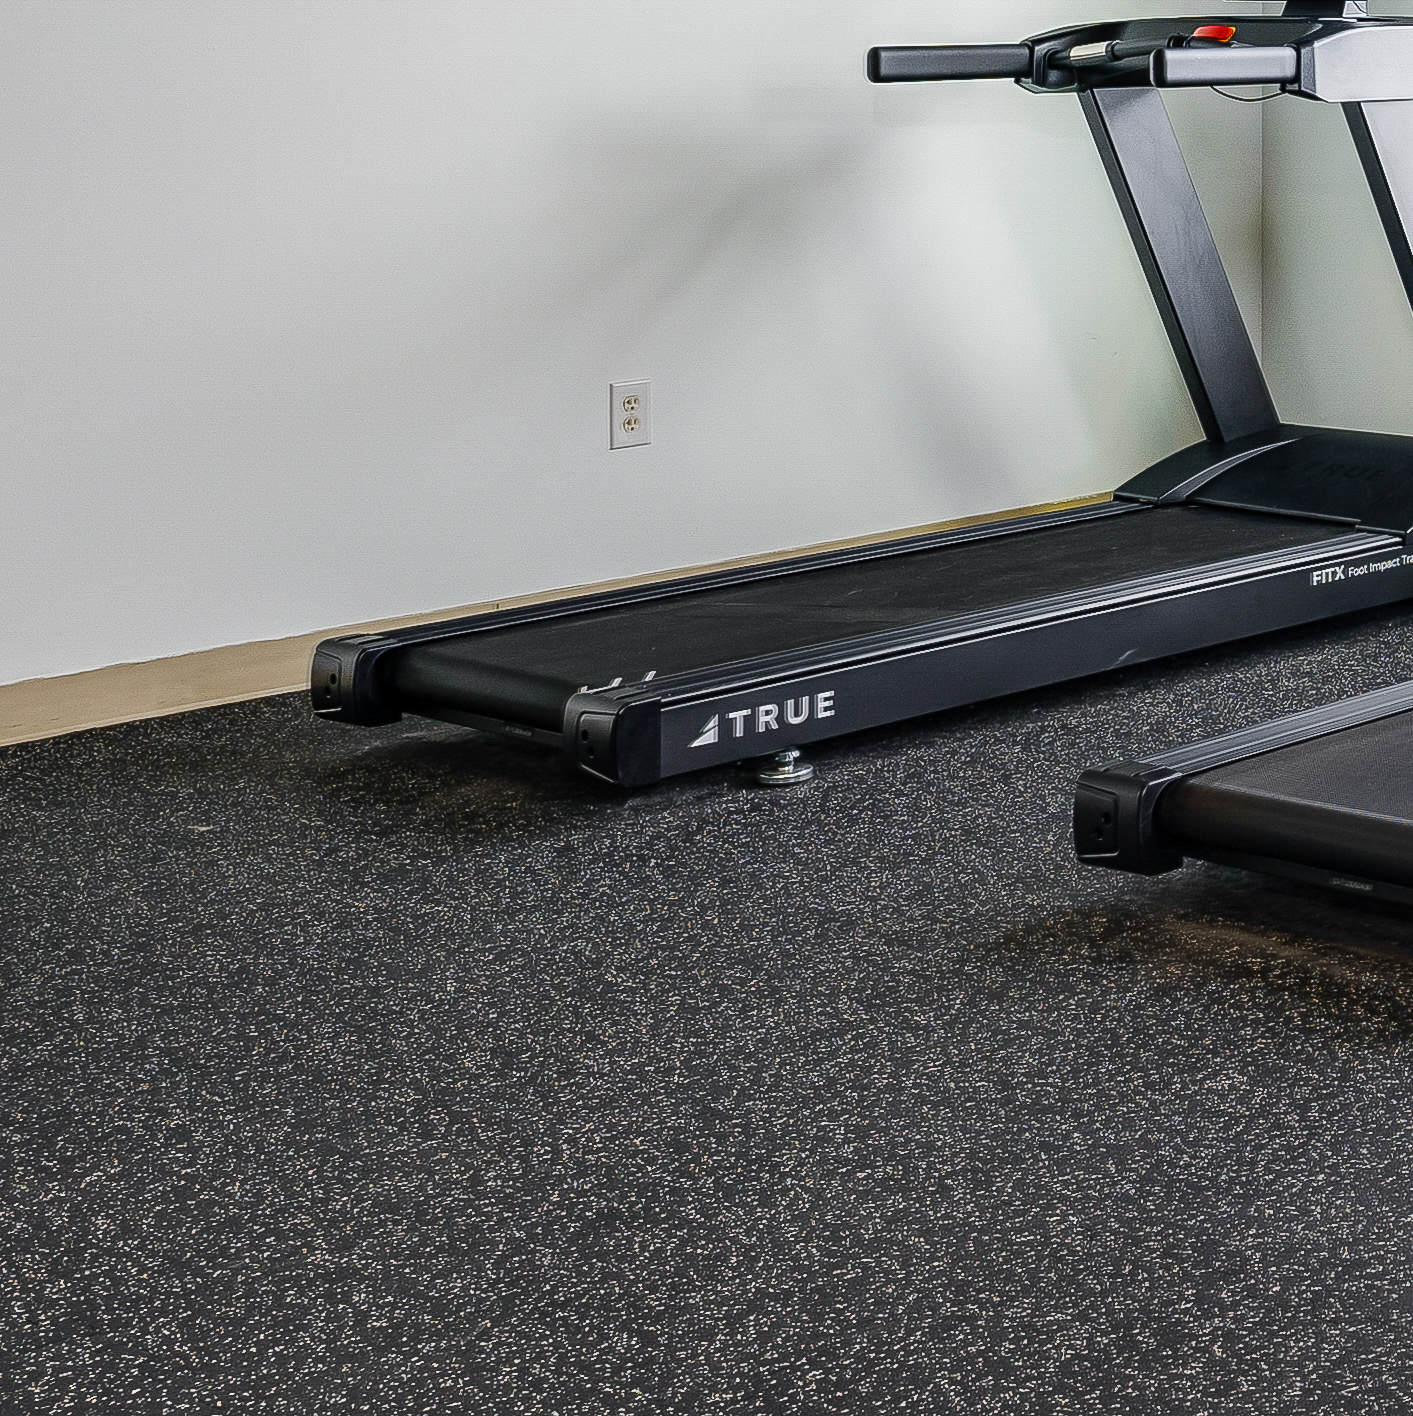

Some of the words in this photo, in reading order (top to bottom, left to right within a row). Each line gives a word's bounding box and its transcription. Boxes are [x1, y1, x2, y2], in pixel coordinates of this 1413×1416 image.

[1311, 565, 1345, 586] FITX
[1348, 563, 1368, 578] Foot
[1369, 557, 1400, 574] Impact
[726, 690, 836, 738] TRUE
